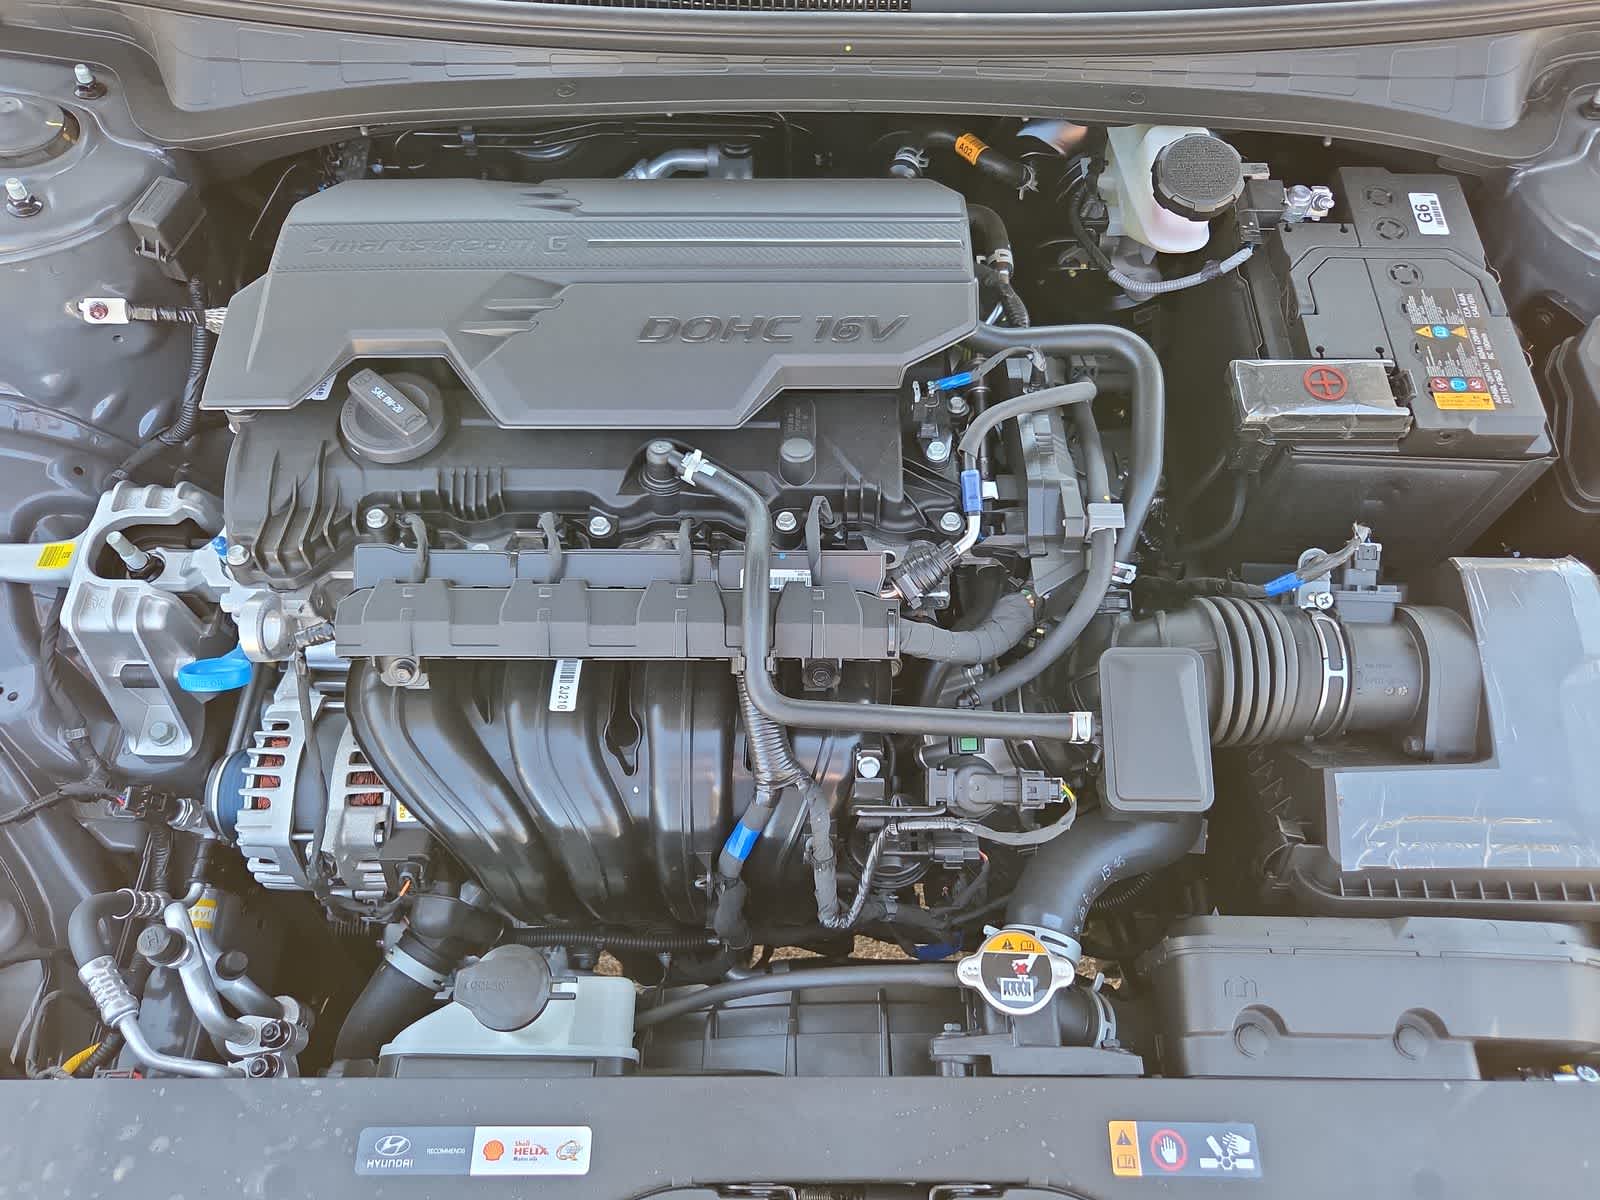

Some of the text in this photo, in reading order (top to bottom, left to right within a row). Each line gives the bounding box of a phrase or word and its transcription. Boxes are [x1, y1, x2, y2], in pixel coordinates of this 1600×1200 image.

[959, 143, 973, 157] A02
[1415, 204, 1433, 223] G6
[304, 234, 569, 255] Smartstream G
[637, 314, 910, 343] DOHC 16V
[371, 386, 404, 413] SAE 0W-20
[557, 685, 570, 710] 2J210
[426, 1147, 466, 1155] RECOMMENDS
[513, 1146, 549, 1156] HELIX
[366, 1159, 415, 1169] HYUNDAI
